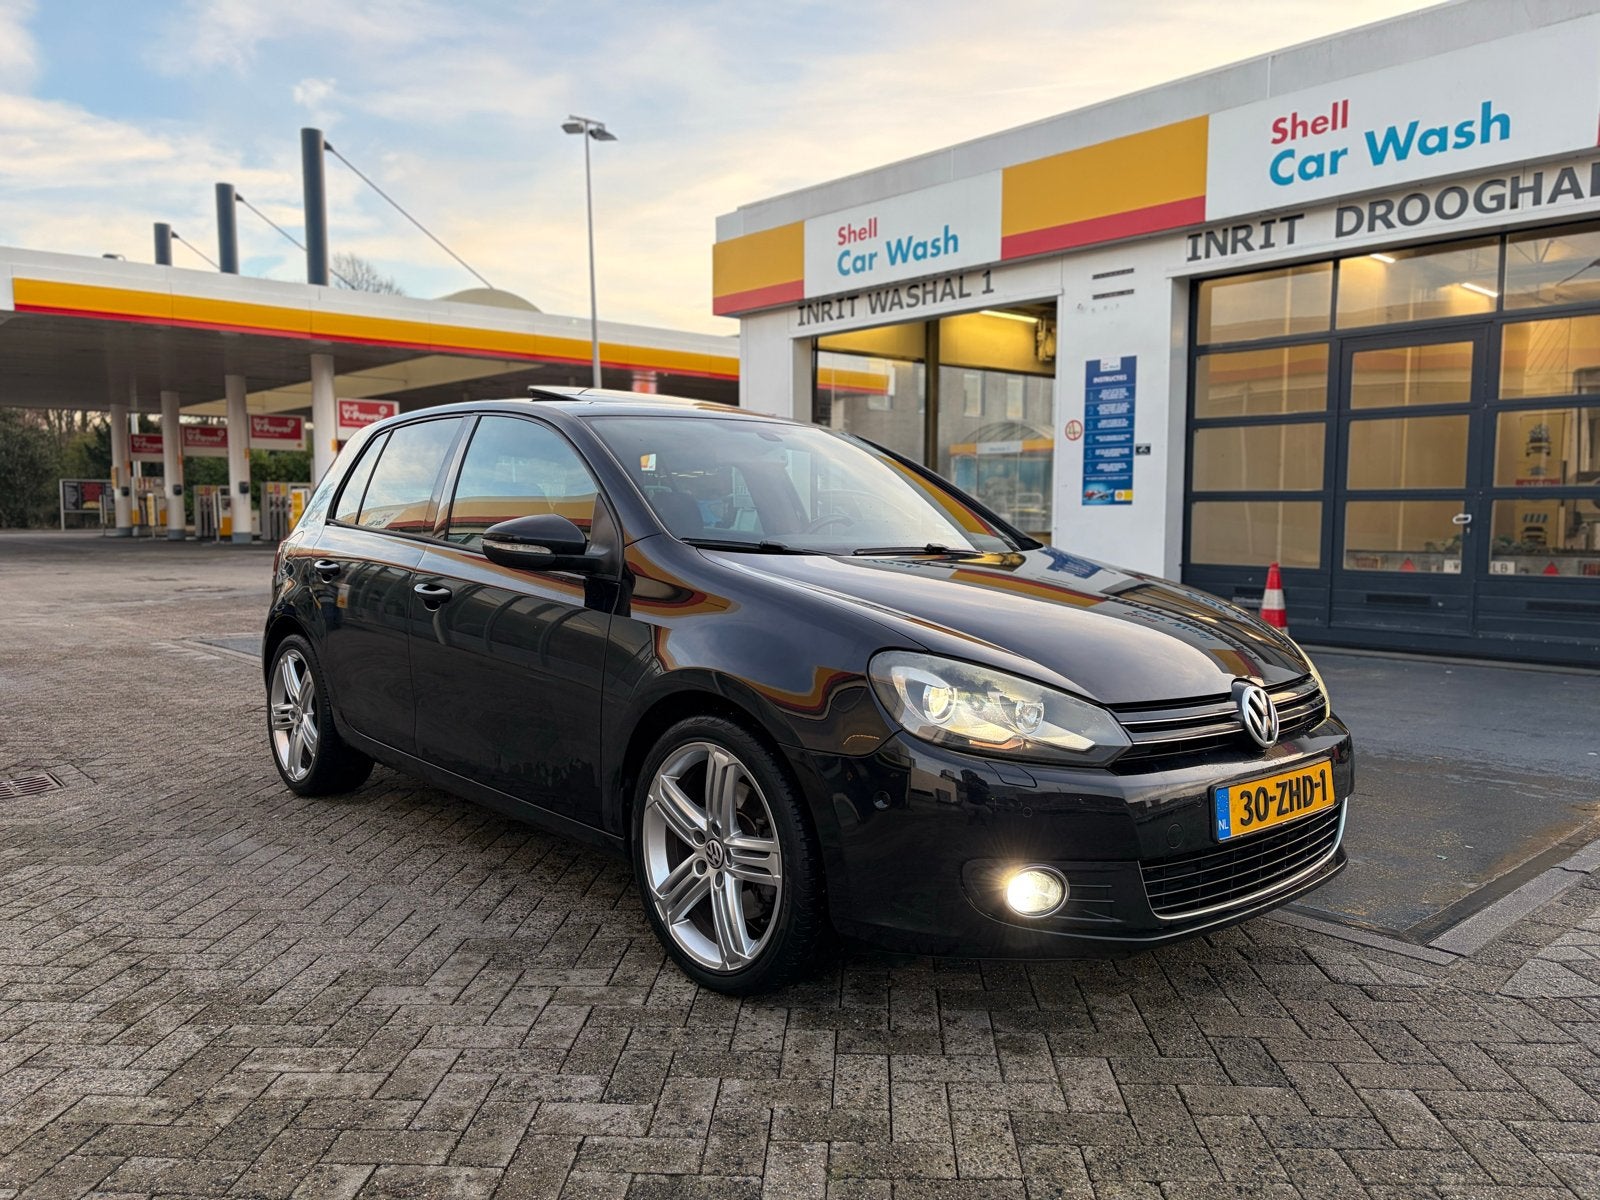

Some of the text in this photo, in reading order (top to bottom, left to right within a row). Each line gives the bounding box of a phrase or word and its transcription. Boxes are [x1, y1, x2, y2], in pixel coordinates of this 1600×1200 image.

[1269, 100, 1511, 186] Car Wash
[1270, 99, 1349, 145] Shell
[837, 217, 878, 246] Shell
[837, 225, 959, 276] Car Wash
[1186, 213, 1304, 263] INRIT
[797, 269, 995, 327] INRIT WASHAL 1
[1239, 769, 1328, 827] 30-ZHD-1
[1218, 819, 1230, 830] NL
